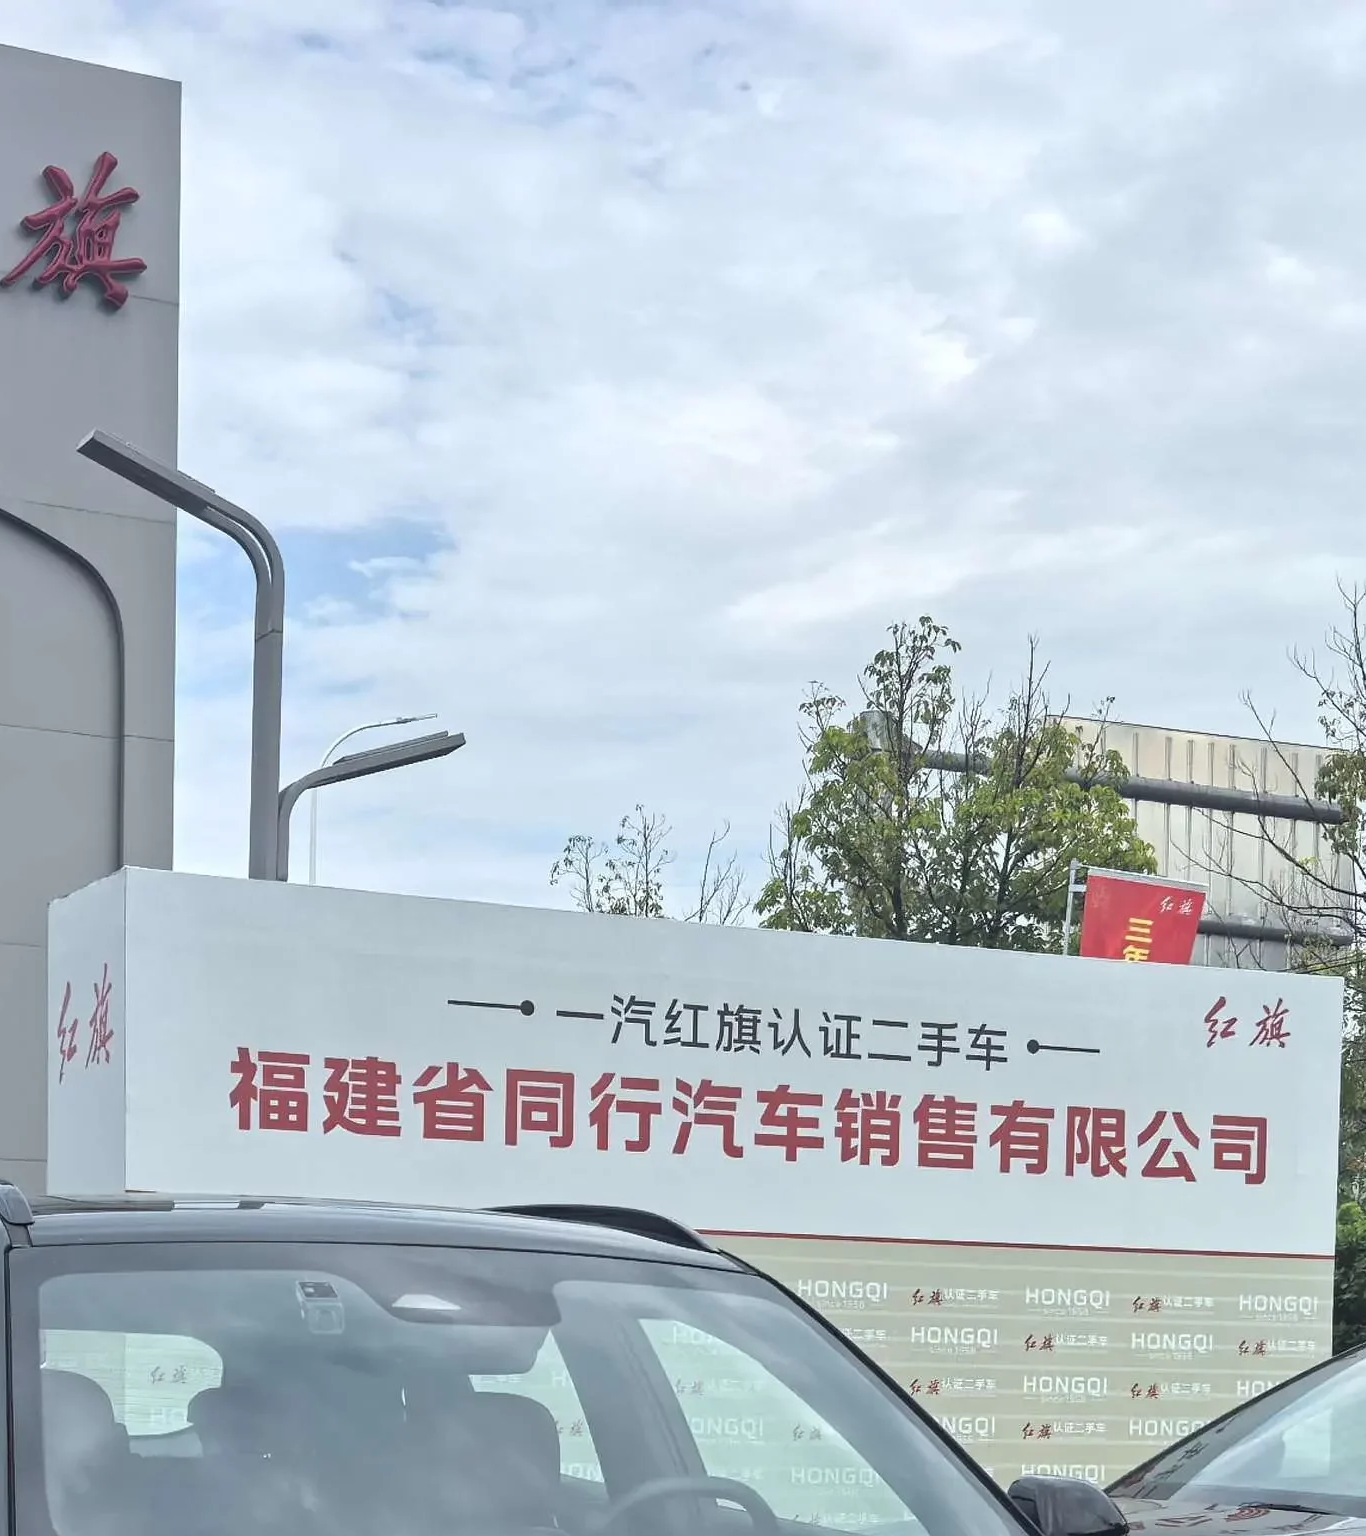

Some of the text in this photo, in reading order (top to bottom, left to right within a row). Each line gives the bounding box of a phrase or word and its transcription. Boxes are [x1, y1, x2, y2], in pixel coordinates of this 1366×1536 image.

[1160, 896, 1193, 915] 红旗
[58, 962, 114, 1085] 红旗
[556, 994, 1010, 1072] 一汽红旗认证二手车
[1204, 996, 1291, 1048] 红旗
[229, 1046, 1269, 1185] 福建省同行汽车销售有限公司
[798, 1279, 887, 1302] HONGQI
[1026, 1286, 1110, 1309] HONGQI
[1239, 1294, 1318, 1316] HONGQI
[911, 1326, 998, 1348] HONGQI
[1131, 1332, 1213, 1353] HONGQI
[1023, 1375, 1108, 1397] HONGQI
[688, 1417, 763, 1439] ONGQI
[934, 1416, 995, 1437] NGQI
